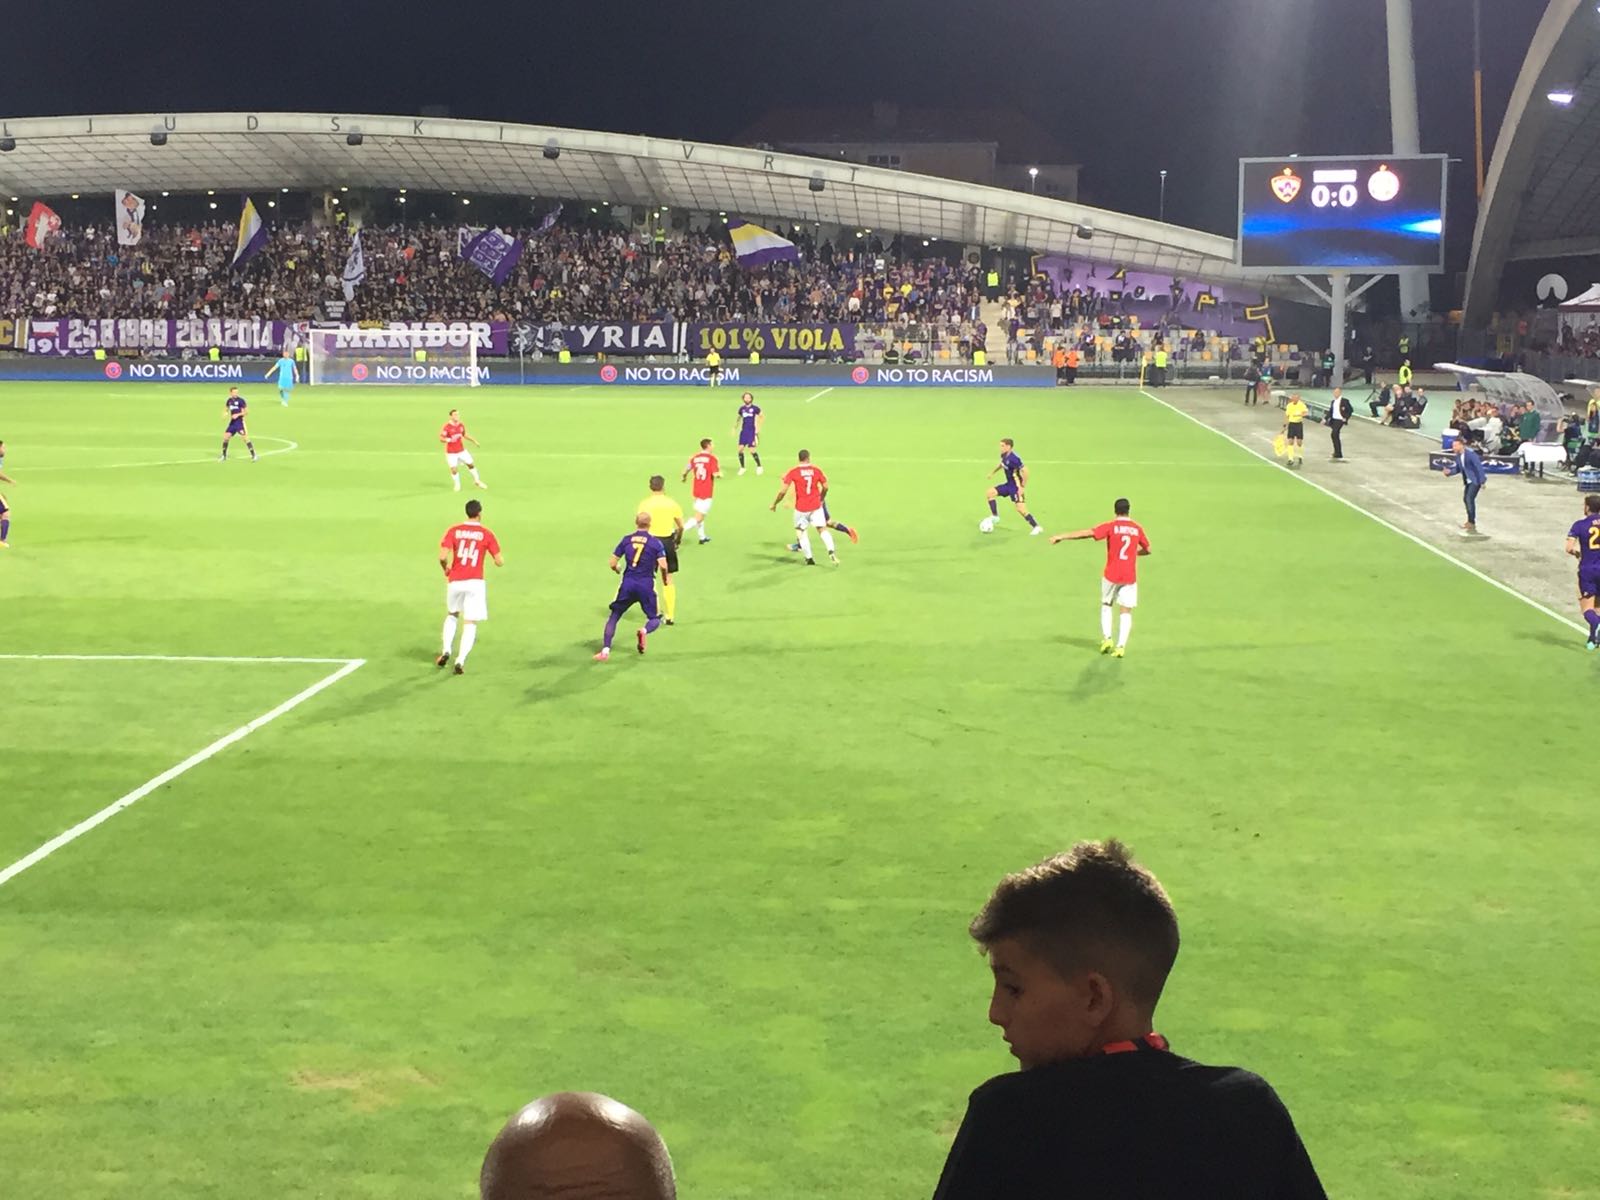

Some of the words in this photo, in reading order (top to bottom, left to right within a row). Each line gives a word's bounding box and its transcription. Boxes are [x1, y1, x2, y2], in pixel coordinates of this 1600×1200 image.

[1311, 184, 1358, 208] 0:0
[68, 319, 168, 349] 25.8.1999
[176, 319, 273, 350] 26.8.2014
[335, 322, 493, 348] MARIBOR
[700, 328, 766, 350] 101%
[770, 328, 845, 350] VIOLA
[129, 364, 155, 377] NO
[158, 364, 180, 377] TO
[182, 364, 243, 378] RACISM
[376, 366, 402, 379] NO
[404, 366, 427, 379] TO
[429, 366, 490, 379] RACISM
[625, 368, 651, 381] NO
[654, 368, 677, 381] TO
[679, 368, 740, 381] RACSM
[877, 369, 903, 382] NO
[905, 369, 929, 382] TO
[932, 369, 994, 383] RACISM
[803, 476, 813, 495] 7
[457, 539, 479, 567] 44
[632, 543, 645, 567] 7
[1119, 535, 1131, 560] 2
